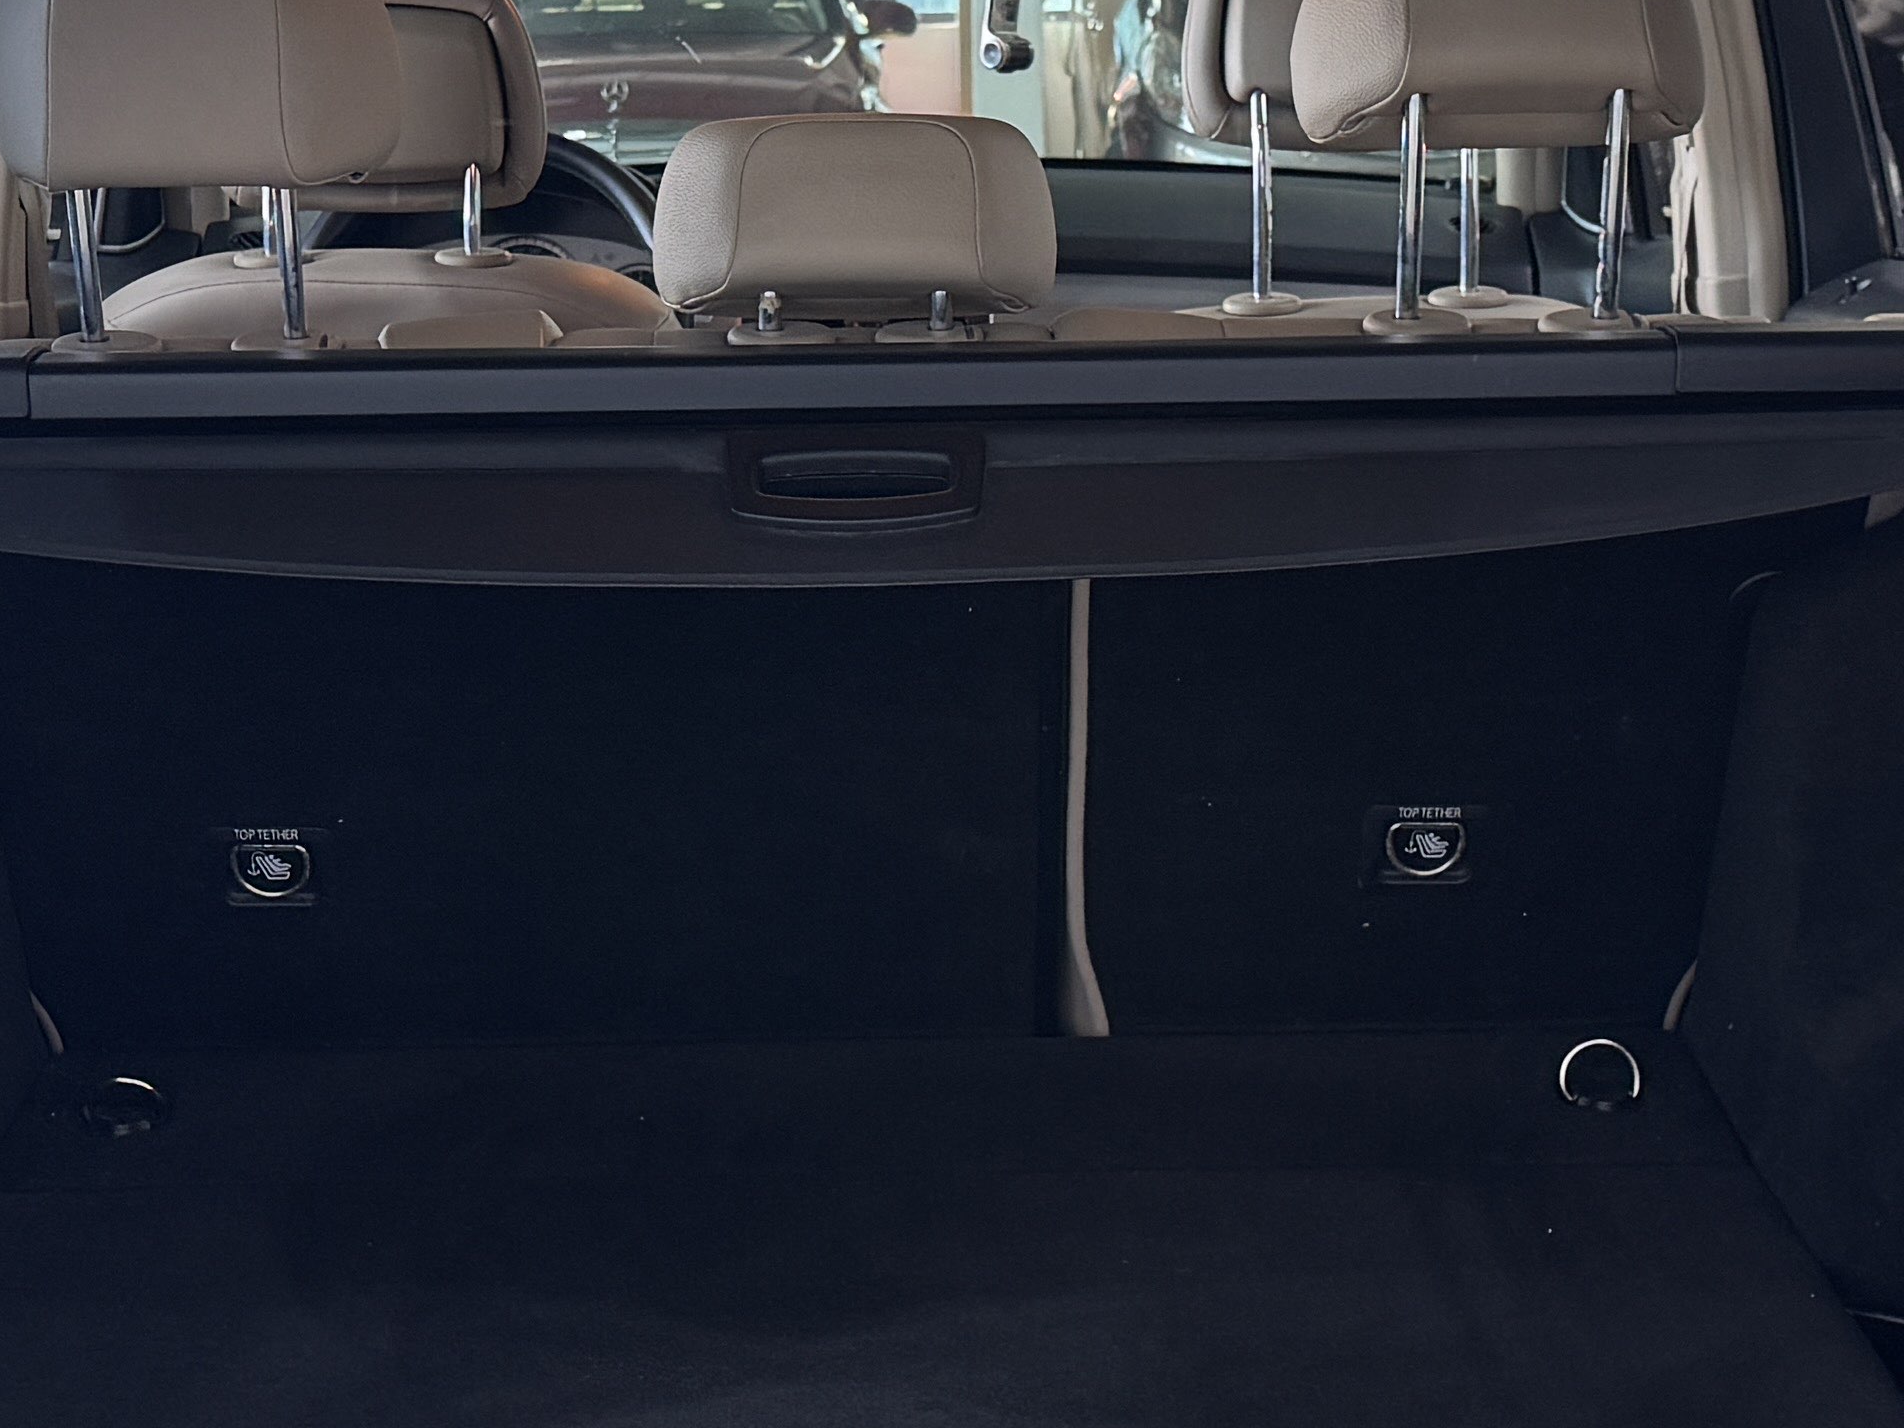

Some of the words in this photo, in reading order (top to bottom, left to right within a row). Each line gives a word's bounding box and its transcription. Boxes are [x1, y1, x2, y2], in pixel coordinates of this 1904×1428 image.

[1398, 806, 1419, 818] TOP
[1422, 806, 1462, 818] TETHER
[234, 828, 256, 840] TOP
[257, 828, 299, 840] TETHER
